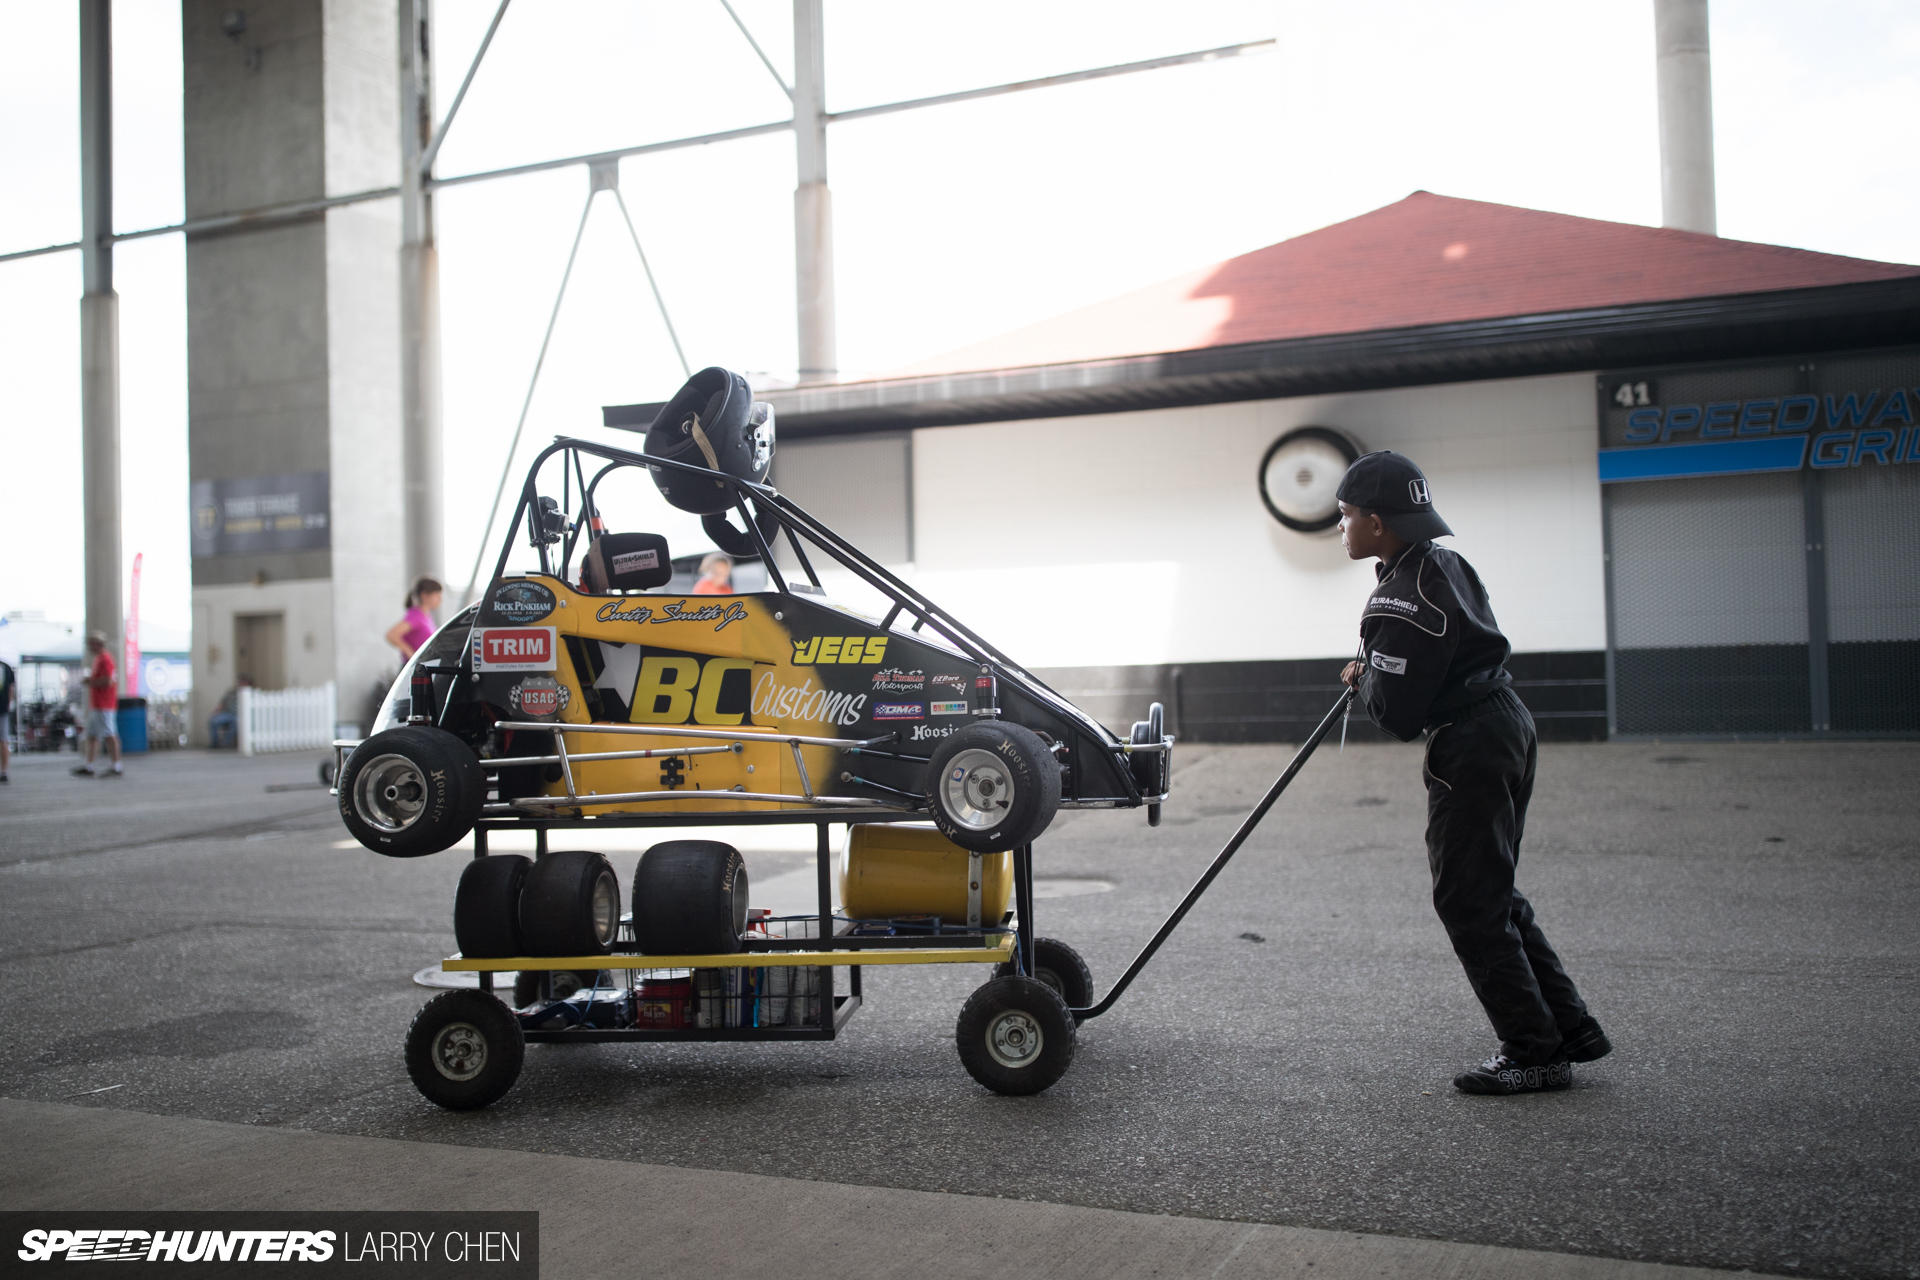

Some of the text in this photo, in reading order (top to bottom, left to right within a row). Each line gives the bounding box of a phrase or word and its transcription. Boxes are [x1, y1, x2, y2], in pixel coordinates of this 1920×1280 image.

[1615, 382, 1650, 407] 41
[493, 601, 551, 611] RICK PINKHAM
[652, 600, 724, 624] Smith
[1393, 598, 1419, 612] SHIELD
[488, 638, 544, 656] TRIM
[792, 636, 889, 665] JEGS
[872, 673, 926, 682] BILL THOMAS
[872, 681, 924, 692] Motorsports
[524, 692, 555, 704] USAC
[629, 656, 755, 725] BC
[750, 671, 867, 726] Customs
[910, 723, 960, 741] Hoosi
[1498, 1061, 1570, 1090] sparco
